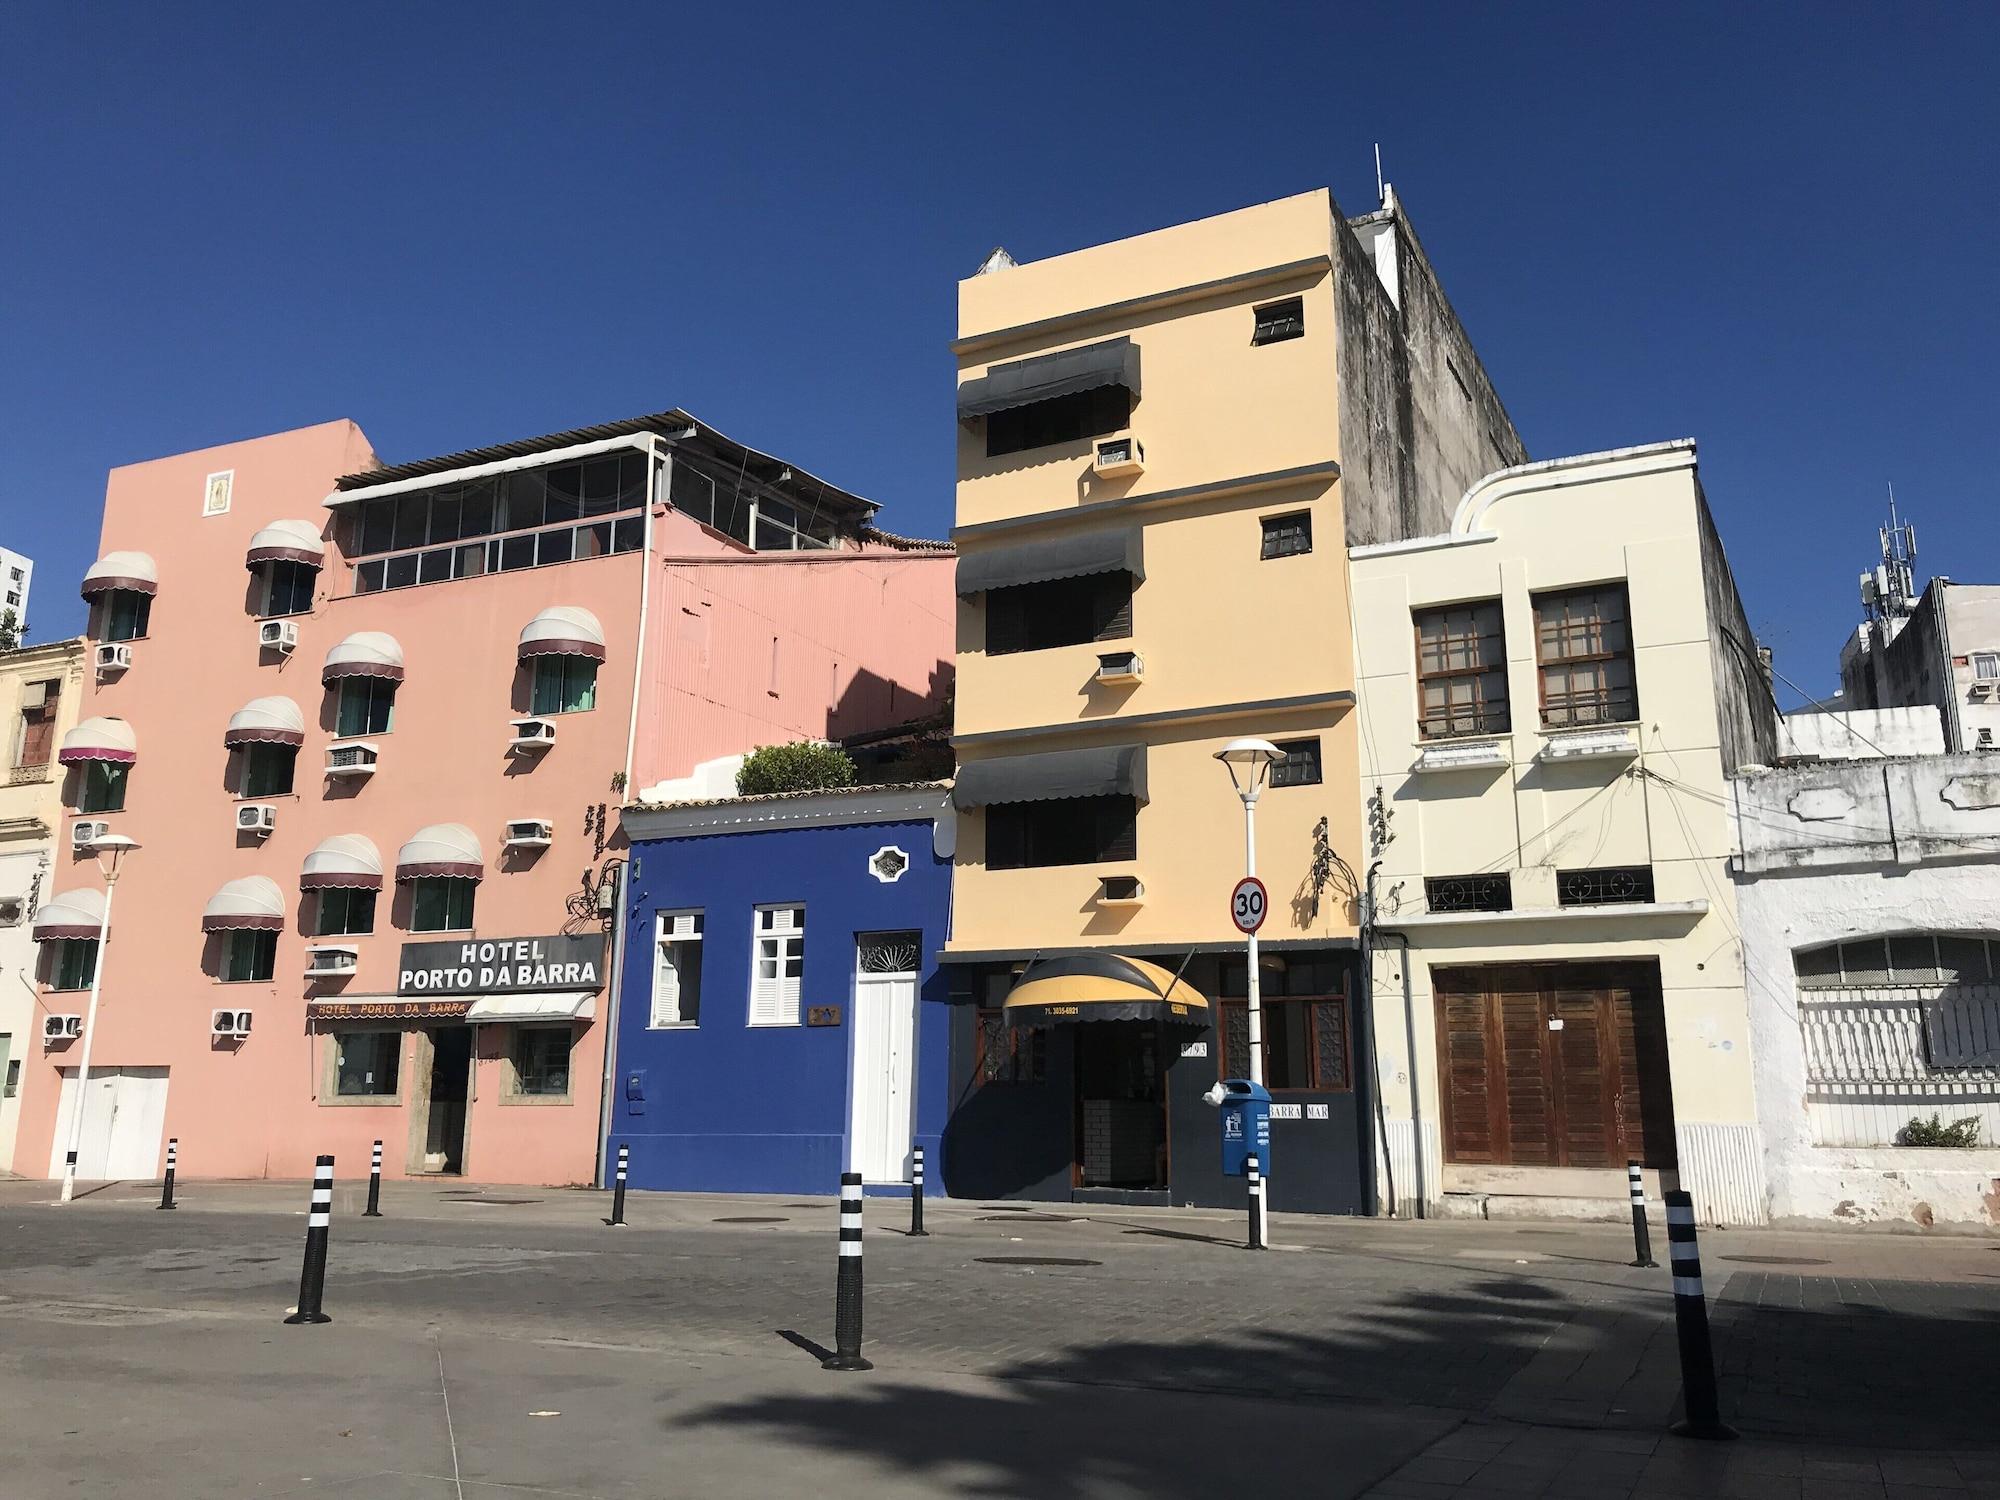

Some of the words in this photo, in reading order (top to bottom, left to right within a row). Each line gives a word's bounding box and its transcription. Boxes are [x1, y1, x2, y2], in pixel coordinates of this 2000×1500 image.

[1236, 891, 1262, 916] 30
[461, 941, 545, 963] HOTEL
[400, 968, 473, 990] PORTO
[479, 966, 511, 987] DA
[516, 962, 597, 985] BARRA
[318, 1005, 351, 1014] HOTEL
[361, 1004, 396, 1013] PORTO
[405, 1003, 419, 1013] DA
[429, 1003, 465, 1012] BARRA
[1308, 1106, 1328, 1118] MAR
